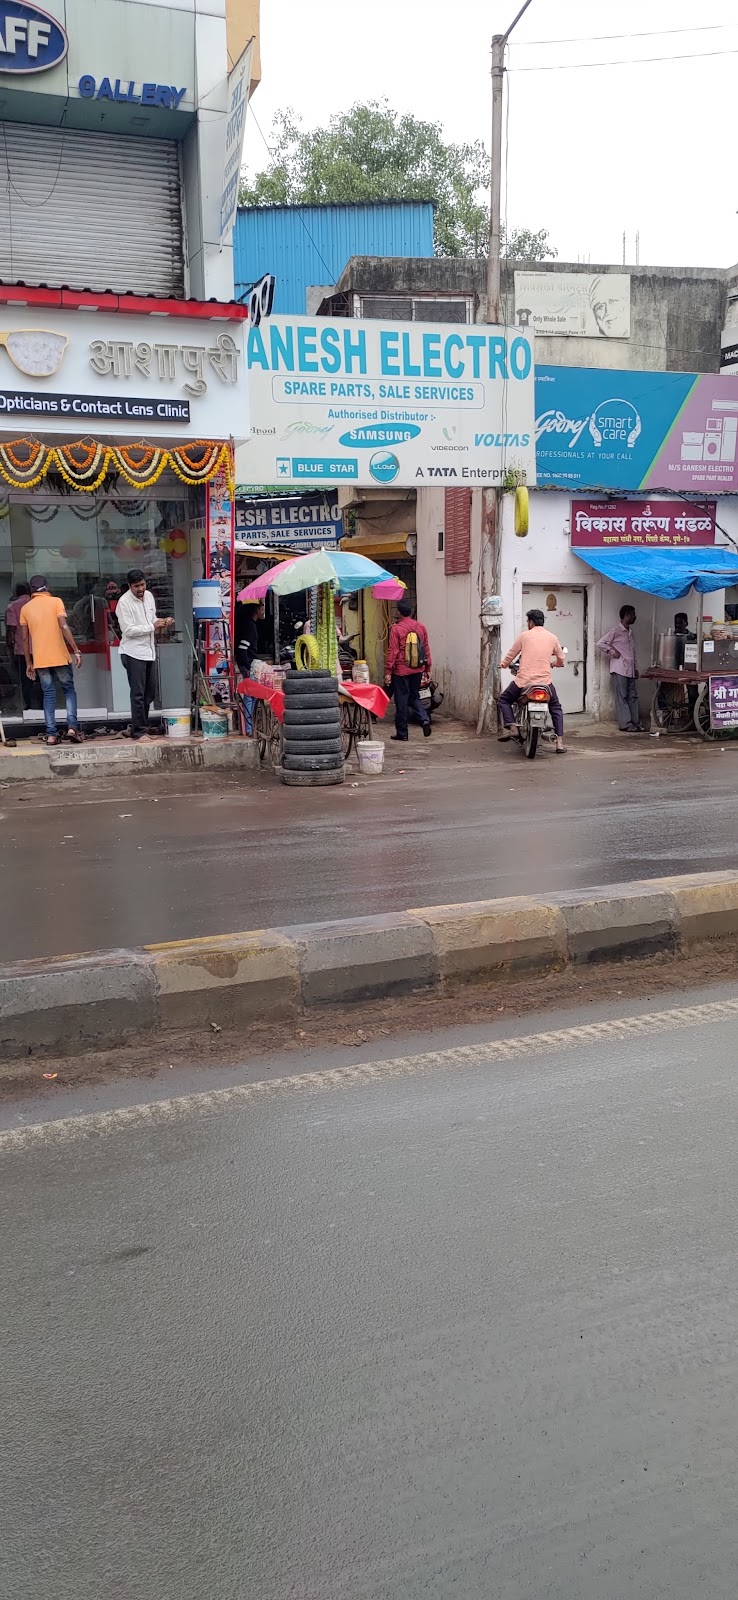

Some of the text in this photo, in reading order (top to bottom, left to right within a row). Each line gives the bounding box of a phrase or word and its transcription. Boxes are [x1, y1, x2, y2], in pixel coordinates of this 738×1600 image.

[0, 15, 51, 58] FF
[78, 74, 187, 109] GALLERY
[532, 315, 543, 324] Only
[556, 315, 567, 323] Sale
[379, 330, 532, 381] ELECTRO
[89, 332, 241, 397] आशापुरी
[284, 381, 475, 401] SPARE PARTS, SALE SERVICES
[0, 395, 58, 412] Opticians
[72, 400, 122, 415] Contact
[125, 402, 154, 416] Lens
[157, 403, 189, 418] Clinic
[328, 409, 378, 420] Authorised
[380, 410, 429, 421] Distributor
[598, 417, 633, 428] smart
[250, 426, 277, 436] lpool
[280, 421, 335, 441] Godrej
[349, 430, 412, 441] SAMSUNG
[535, 410, 590, 449] Godrej
[602, 429, 627, 440] care
[474, 433, 531, 447] VOLTAS
[598, 452, 615, 460] YOUR
[297, 463, 355, 473] BLUE STAR
[415, 467, 527, 480] A TATA Enterprises
[668, 464, 735, 473] M/S GANESH ELECTRO
[691, 474, 706, 482] SPARE
[706, 474, 717, 482] PART
[271, 504, 342, 524] ELECTRO
[575, 511, 627, 532] विकास
[674, 511, 712, 532] मंडळ
[241, 531, 270, 540] PARTS,
[271, 529, 290, 538] SALE
[294, 527, 332, 537] SERVICES
[713, 685, 728, 700] श्री
